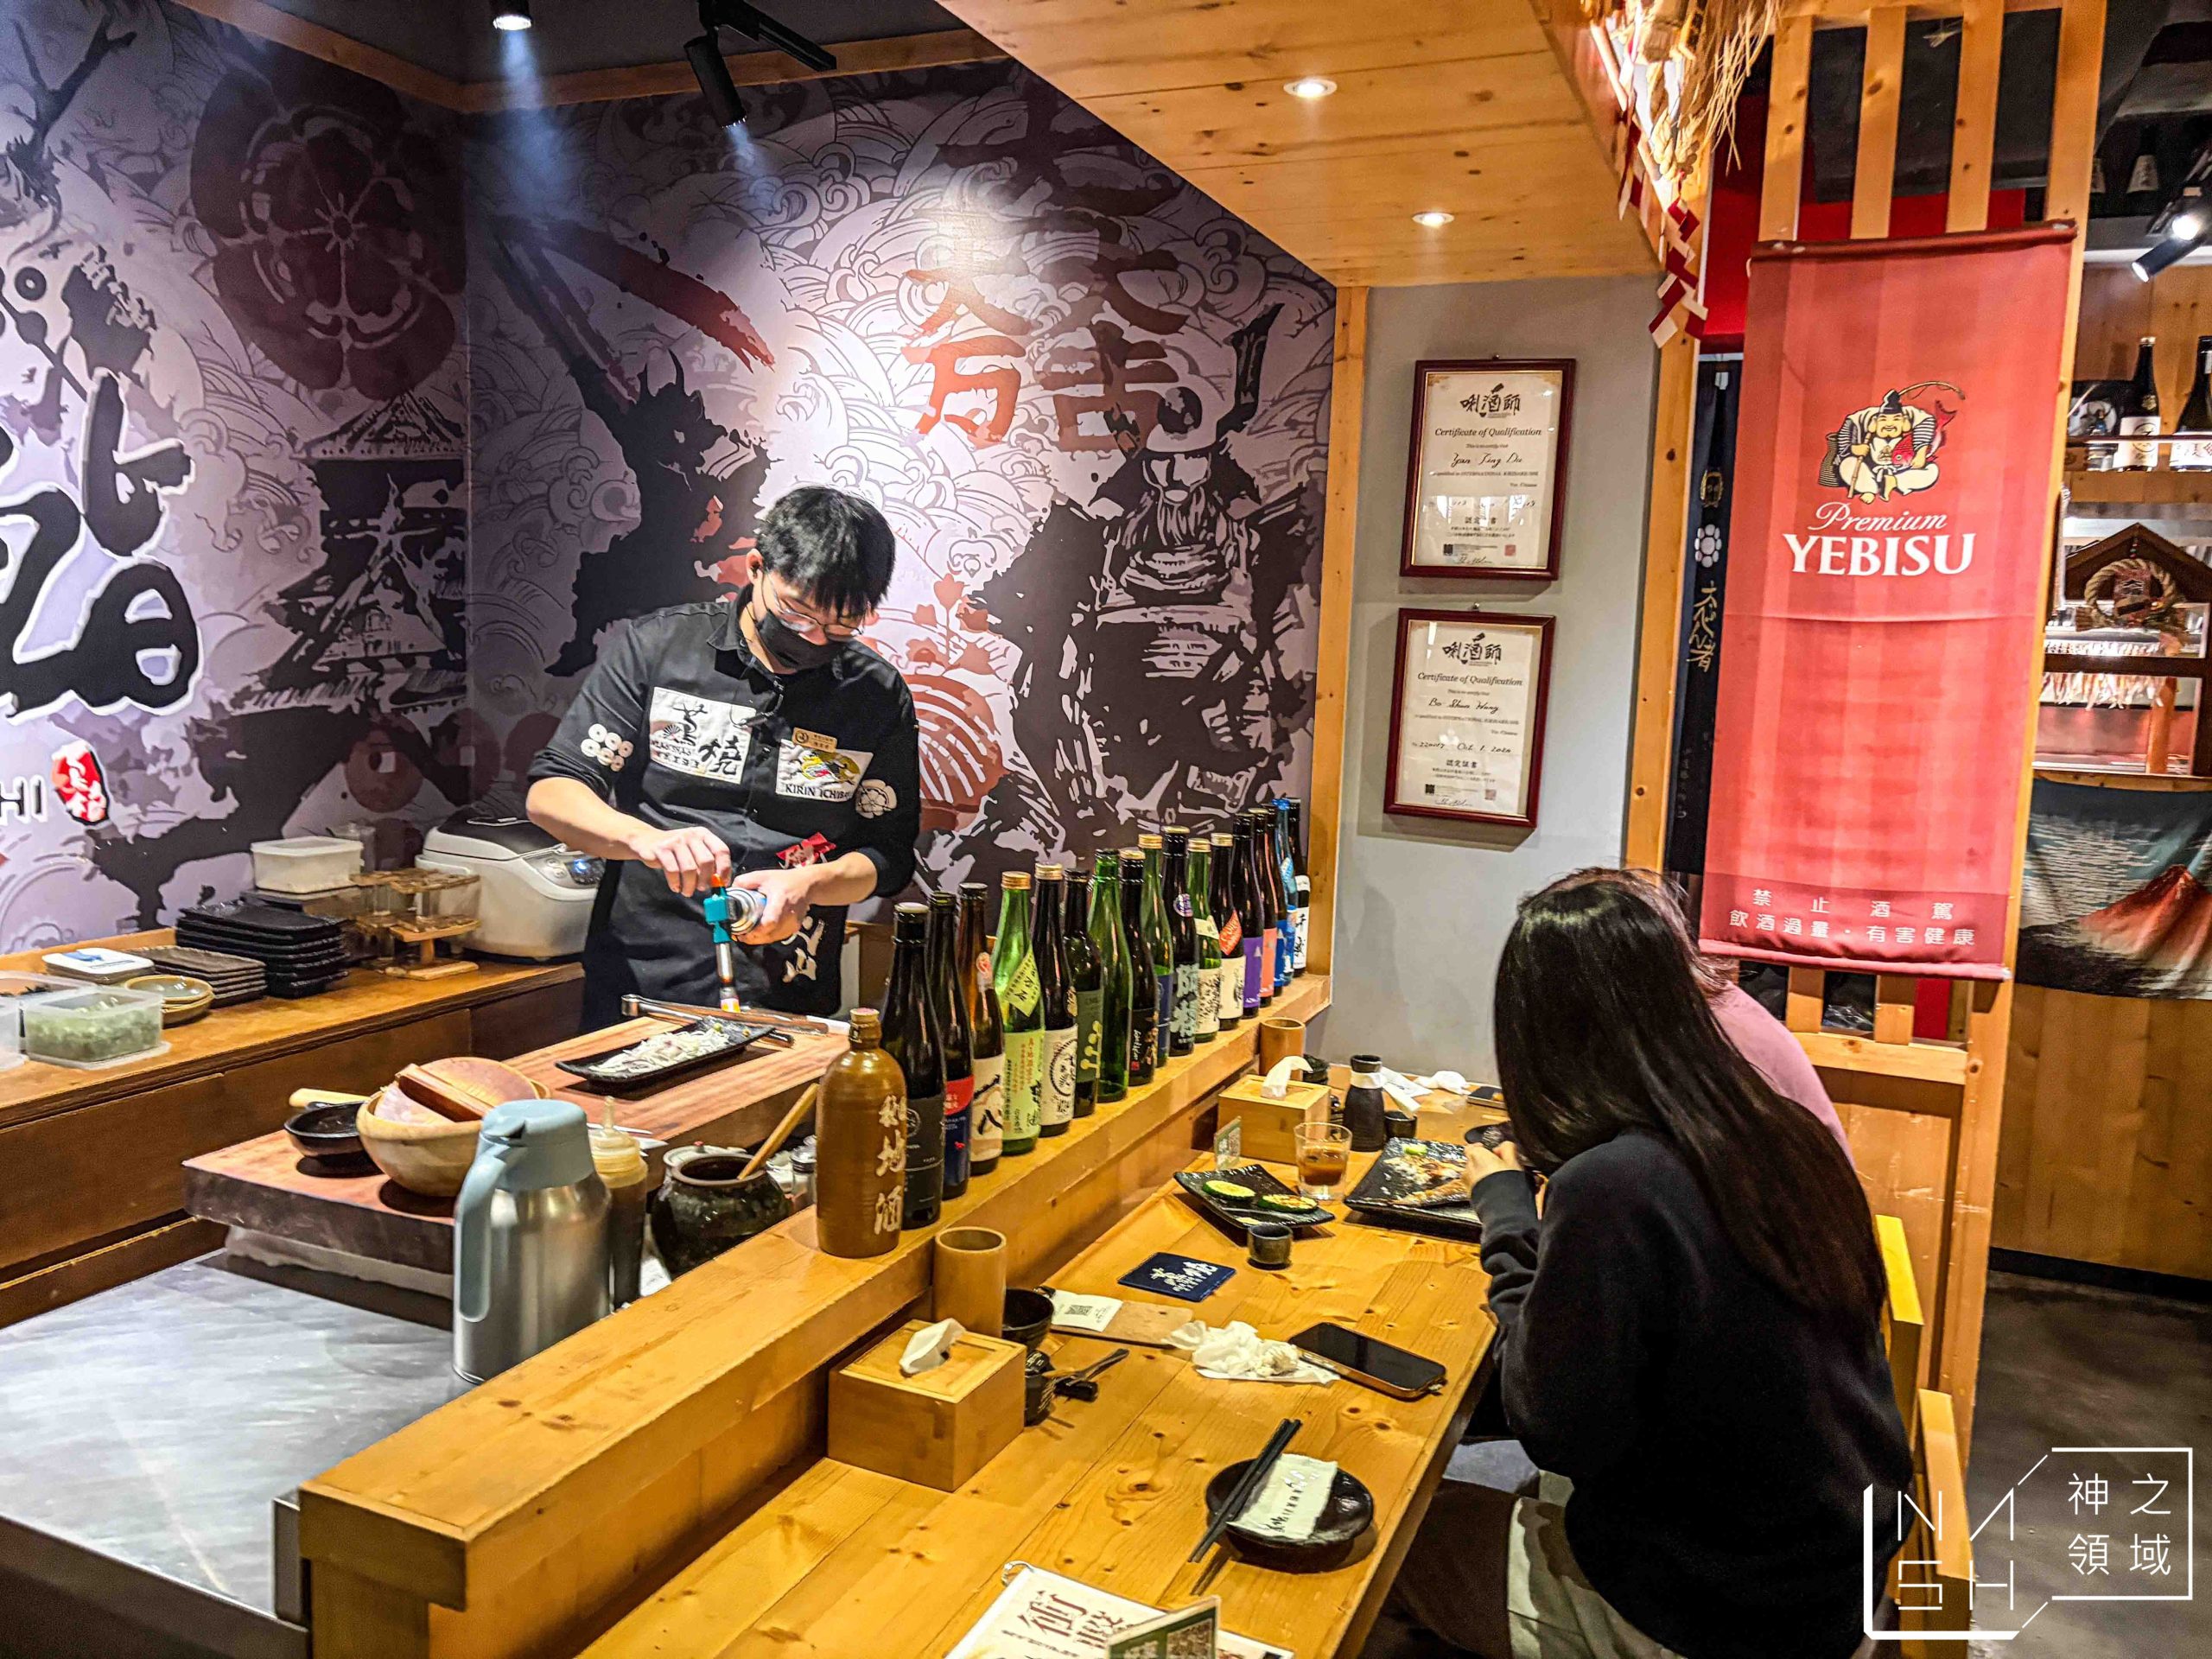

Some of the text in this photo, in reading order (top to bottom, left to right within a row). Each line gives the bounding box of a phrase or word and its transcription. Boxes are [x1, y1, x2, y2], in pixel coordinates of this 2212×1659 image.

[1434, 427, 1541, 439] Certificate of Qualification
[1808, 501, 1948, 533] Premium
[1783, 533, 1978, 578] YEBISU
[1417, 671, 1523, 688] Certificate of Qualification
[785, 784, 816, 797] KIRIN
[1752, 887, 1955, 921] 禁止酒駕
